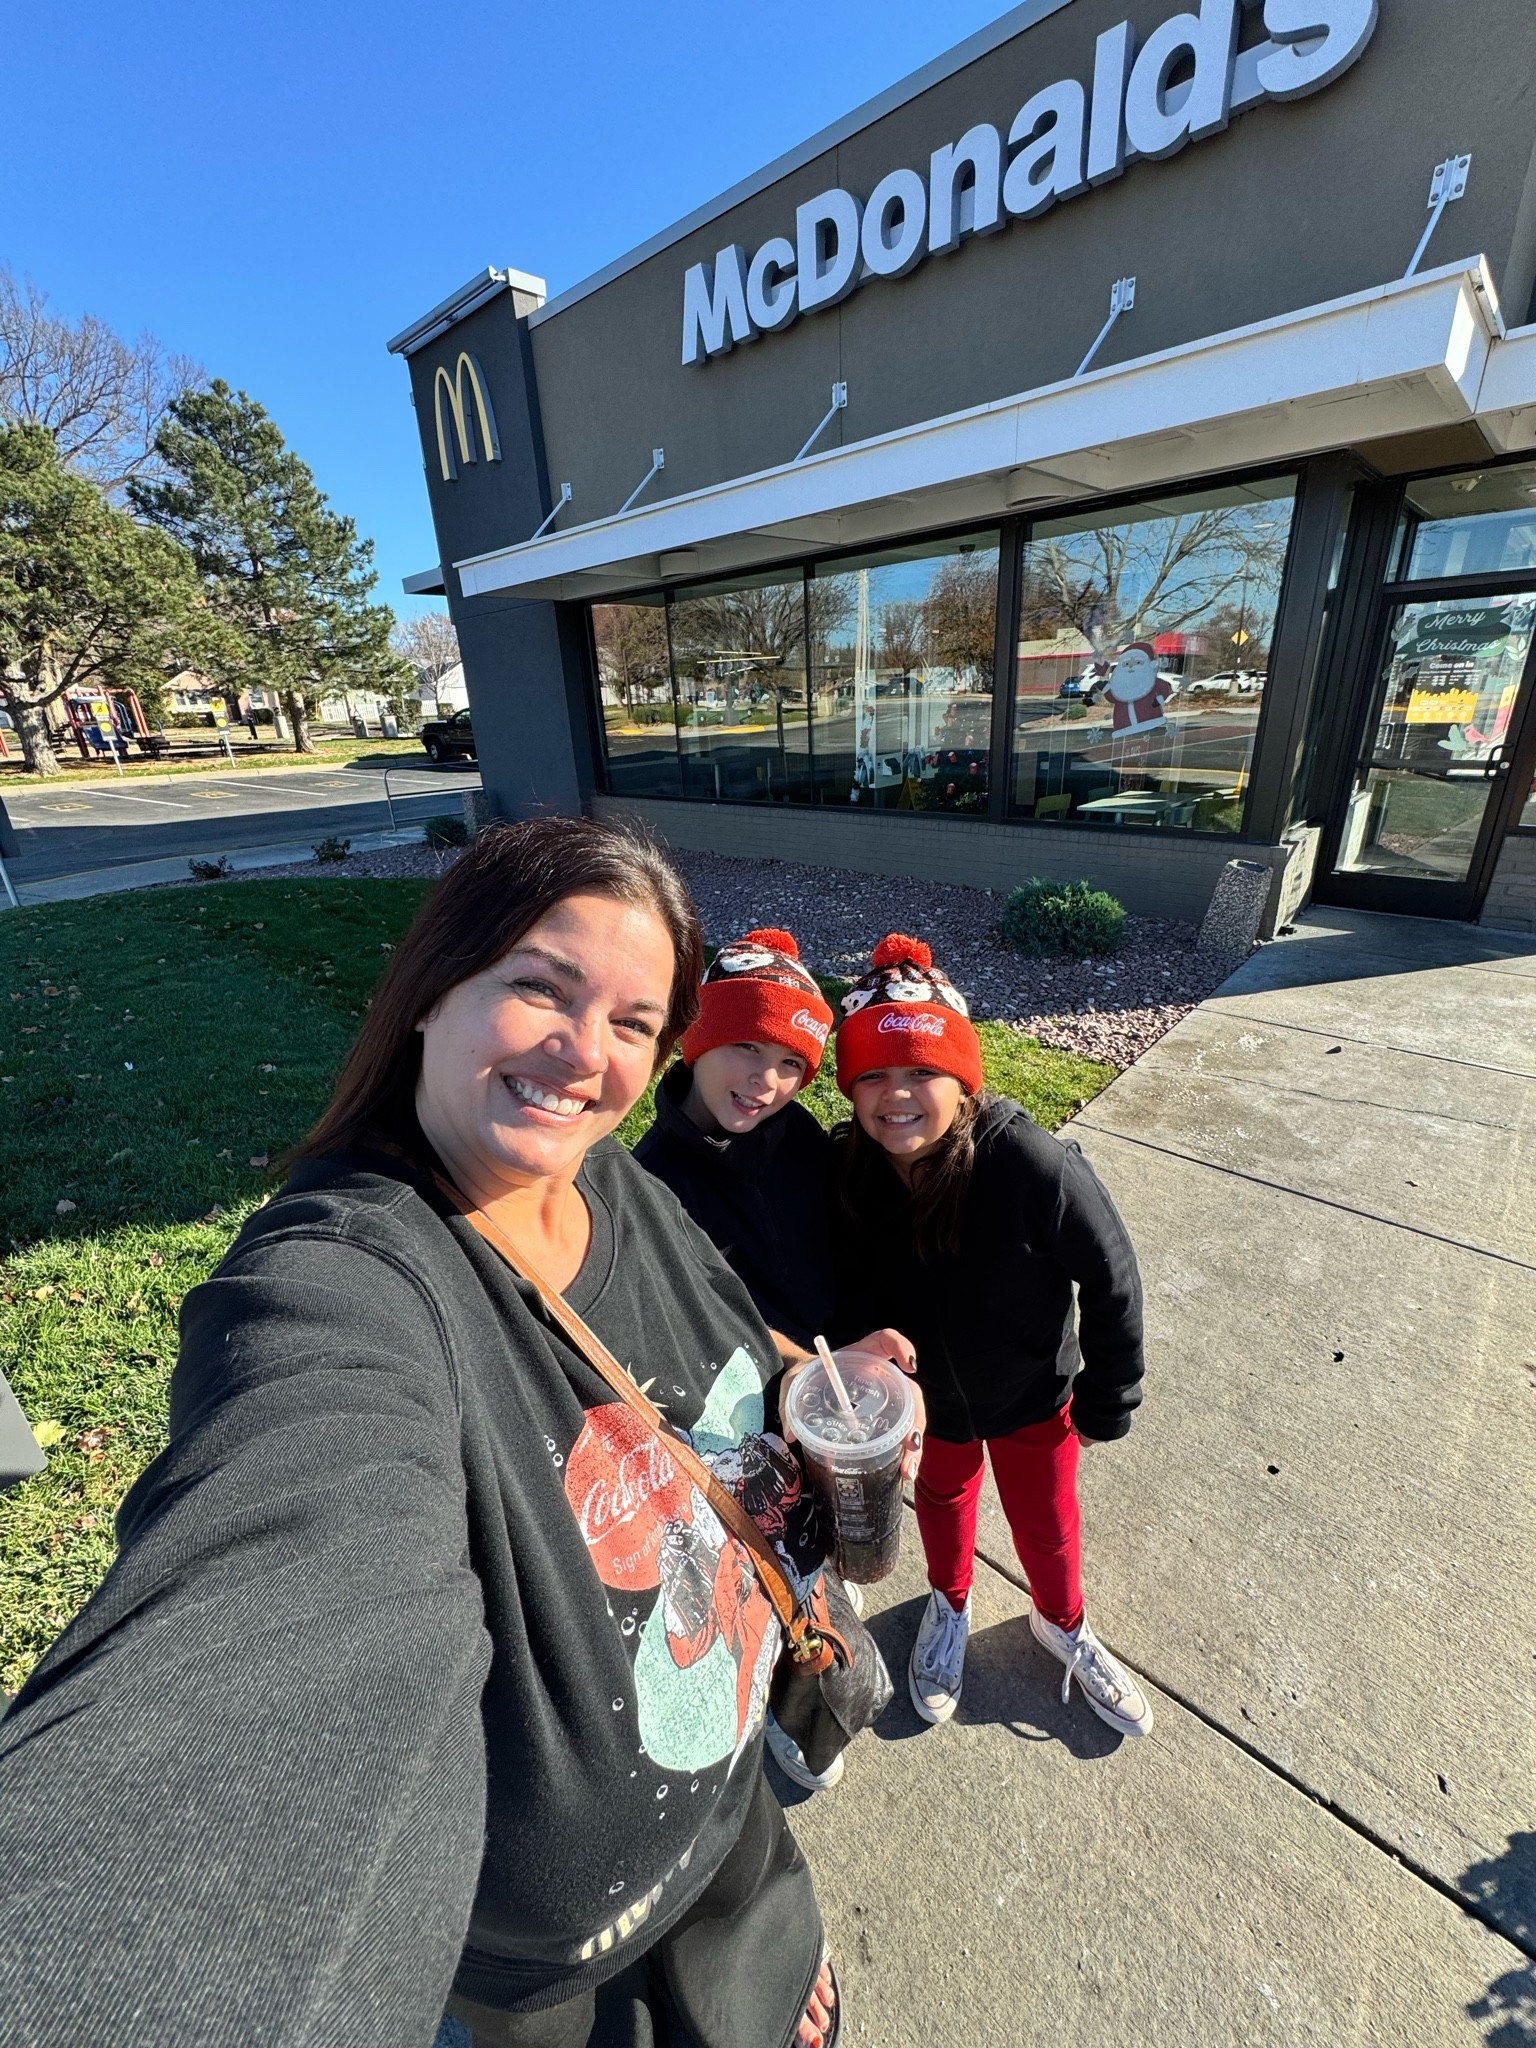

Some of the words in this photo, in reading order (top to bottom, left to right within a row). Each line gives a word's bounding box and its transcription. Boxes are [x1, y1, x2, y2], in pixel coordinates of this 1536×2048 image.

[681, 0, 1377, 367] McDonalds
[1425, 612, 1486, 630] Merry
[1416, 638, 1501, 653] Christmas
[613, 1548, 642, 1575] Sign
